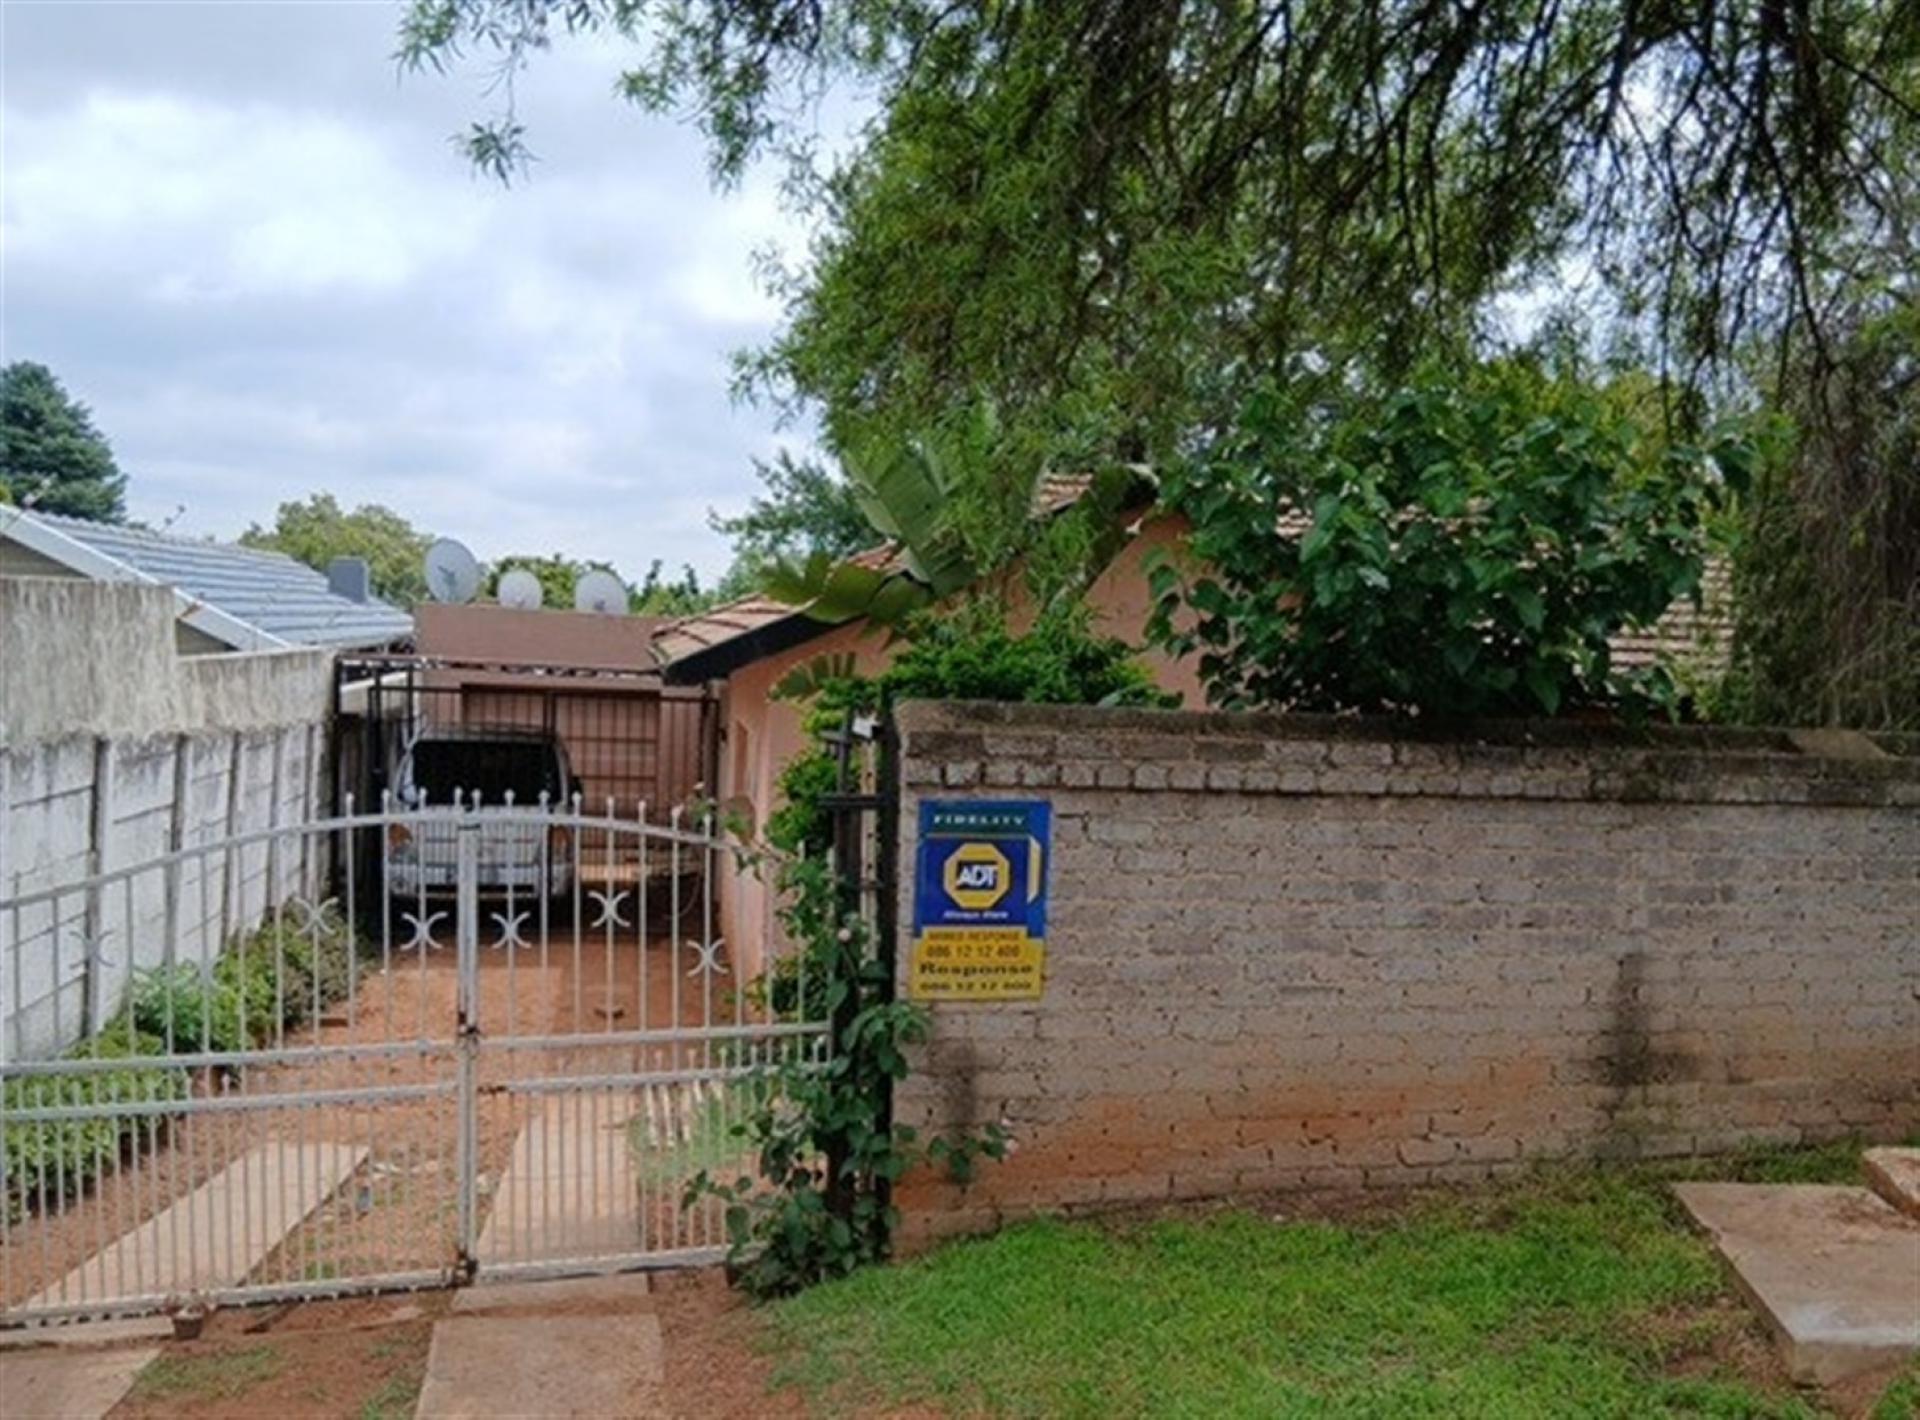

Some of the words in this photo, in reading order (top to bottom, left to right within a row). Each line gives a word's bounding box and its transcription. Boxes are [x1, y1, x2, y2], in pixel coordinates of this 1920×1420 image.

[934, 814, 1025, 825] FIDELITY
[956, 864, 999, 887] ADT
[919, 961, 1033, 977] Response
